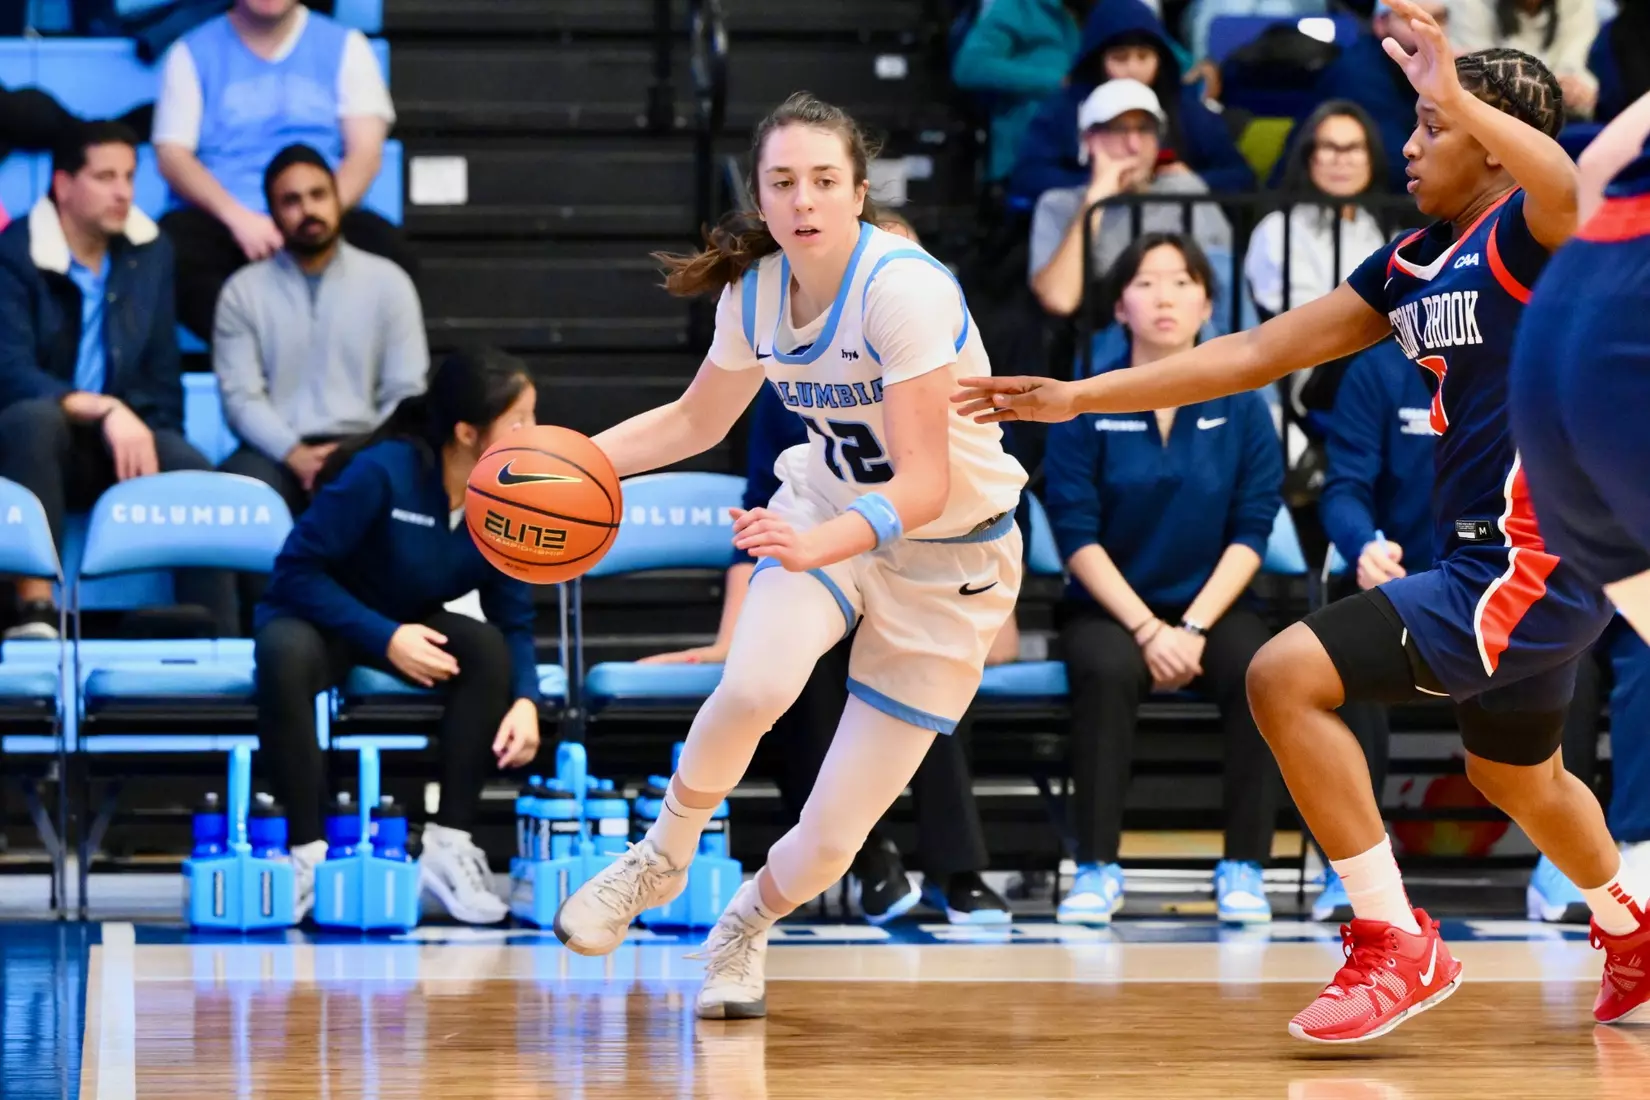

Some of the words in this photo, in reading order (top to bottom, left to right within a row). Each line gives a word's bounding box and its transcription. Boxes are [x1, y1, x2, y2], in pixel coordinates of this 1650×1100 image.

[1454, 252, 1480, 269] CAA
[1421, 291, 1483, 349] BROOK
[771, 377, 883, 409] LUMBIA
[799, 413, 895, 484] 12
[112, 504, 271, 525] COLUMBIA
[484, 509, 567, 550] ELITE
[1479, 526, 1487, 535] M
